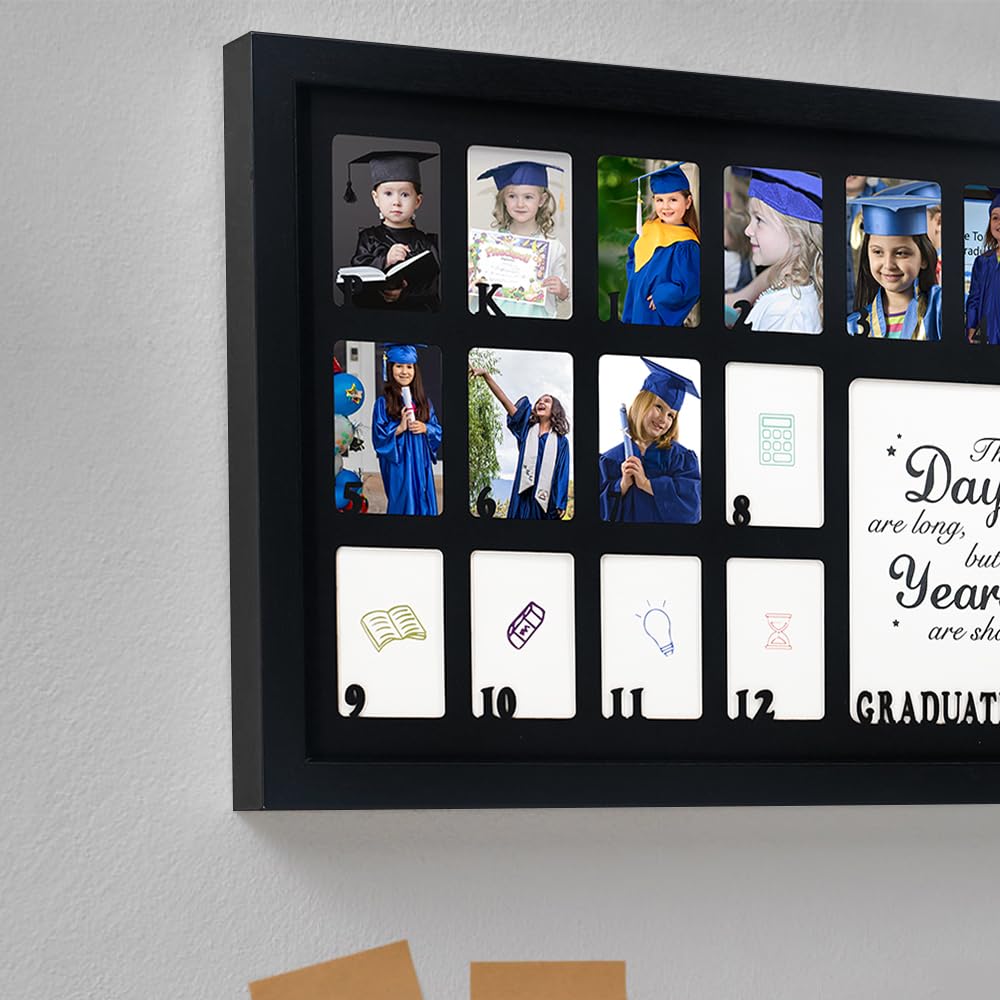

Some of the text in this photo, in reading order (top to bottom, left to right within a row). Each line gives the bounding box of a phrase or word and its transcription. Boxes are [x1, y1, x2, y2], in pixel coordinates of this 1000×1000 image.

[475, 282, 506, 317] K
[732, 299, 755, 332] 2
[343, 481, 367, 514] 5
[476, 486, 497, 519] 6
[732, 494, 751, 527] 8
[867, 509, 965, 545] are long,
[928, 626, 967, 641] are
[344, 684, 366, 719] 9
[480, 686, 517, 719] 10
[610, 687, 645, 719] 11
[735, 688, 775, 720] 12
